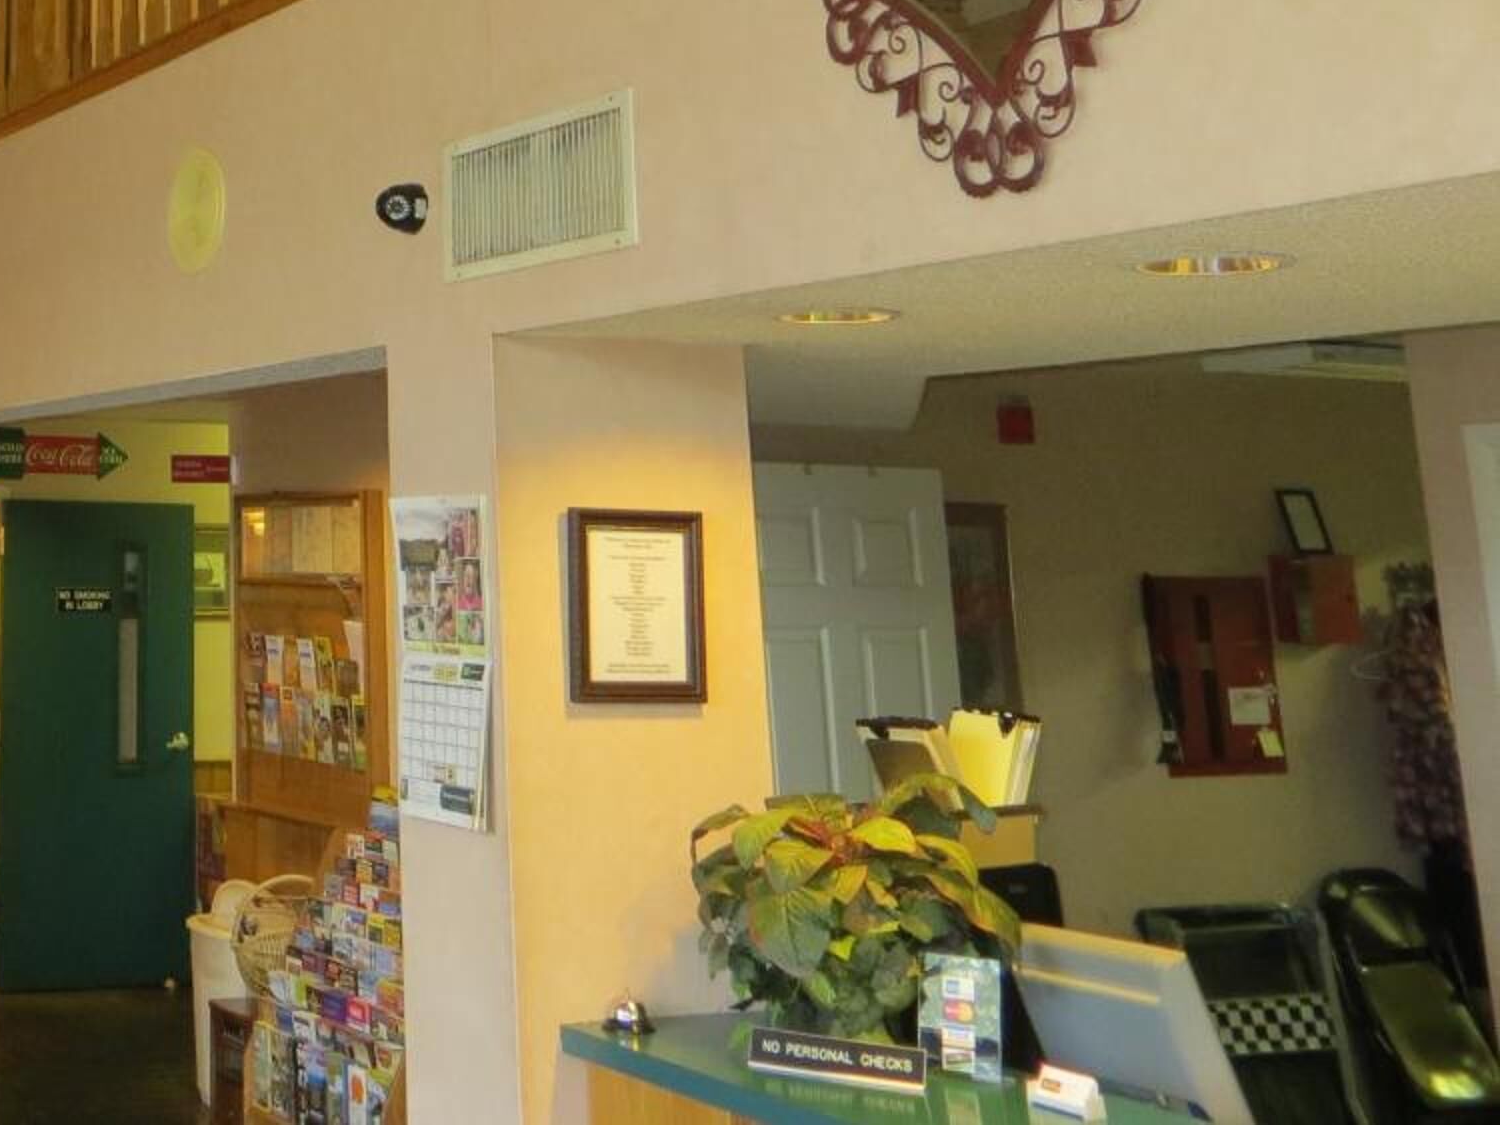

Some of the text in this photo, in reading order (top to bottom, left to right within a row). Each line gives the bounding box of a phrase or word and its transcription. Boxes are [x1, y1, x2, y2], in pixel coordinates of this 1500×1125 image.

[59, 590, 111, 600] NO SMOKING
[76, 601, 103, 611] LOBBY
[761, 1038, 913, 1073] NO PERSONAL CHECKS
